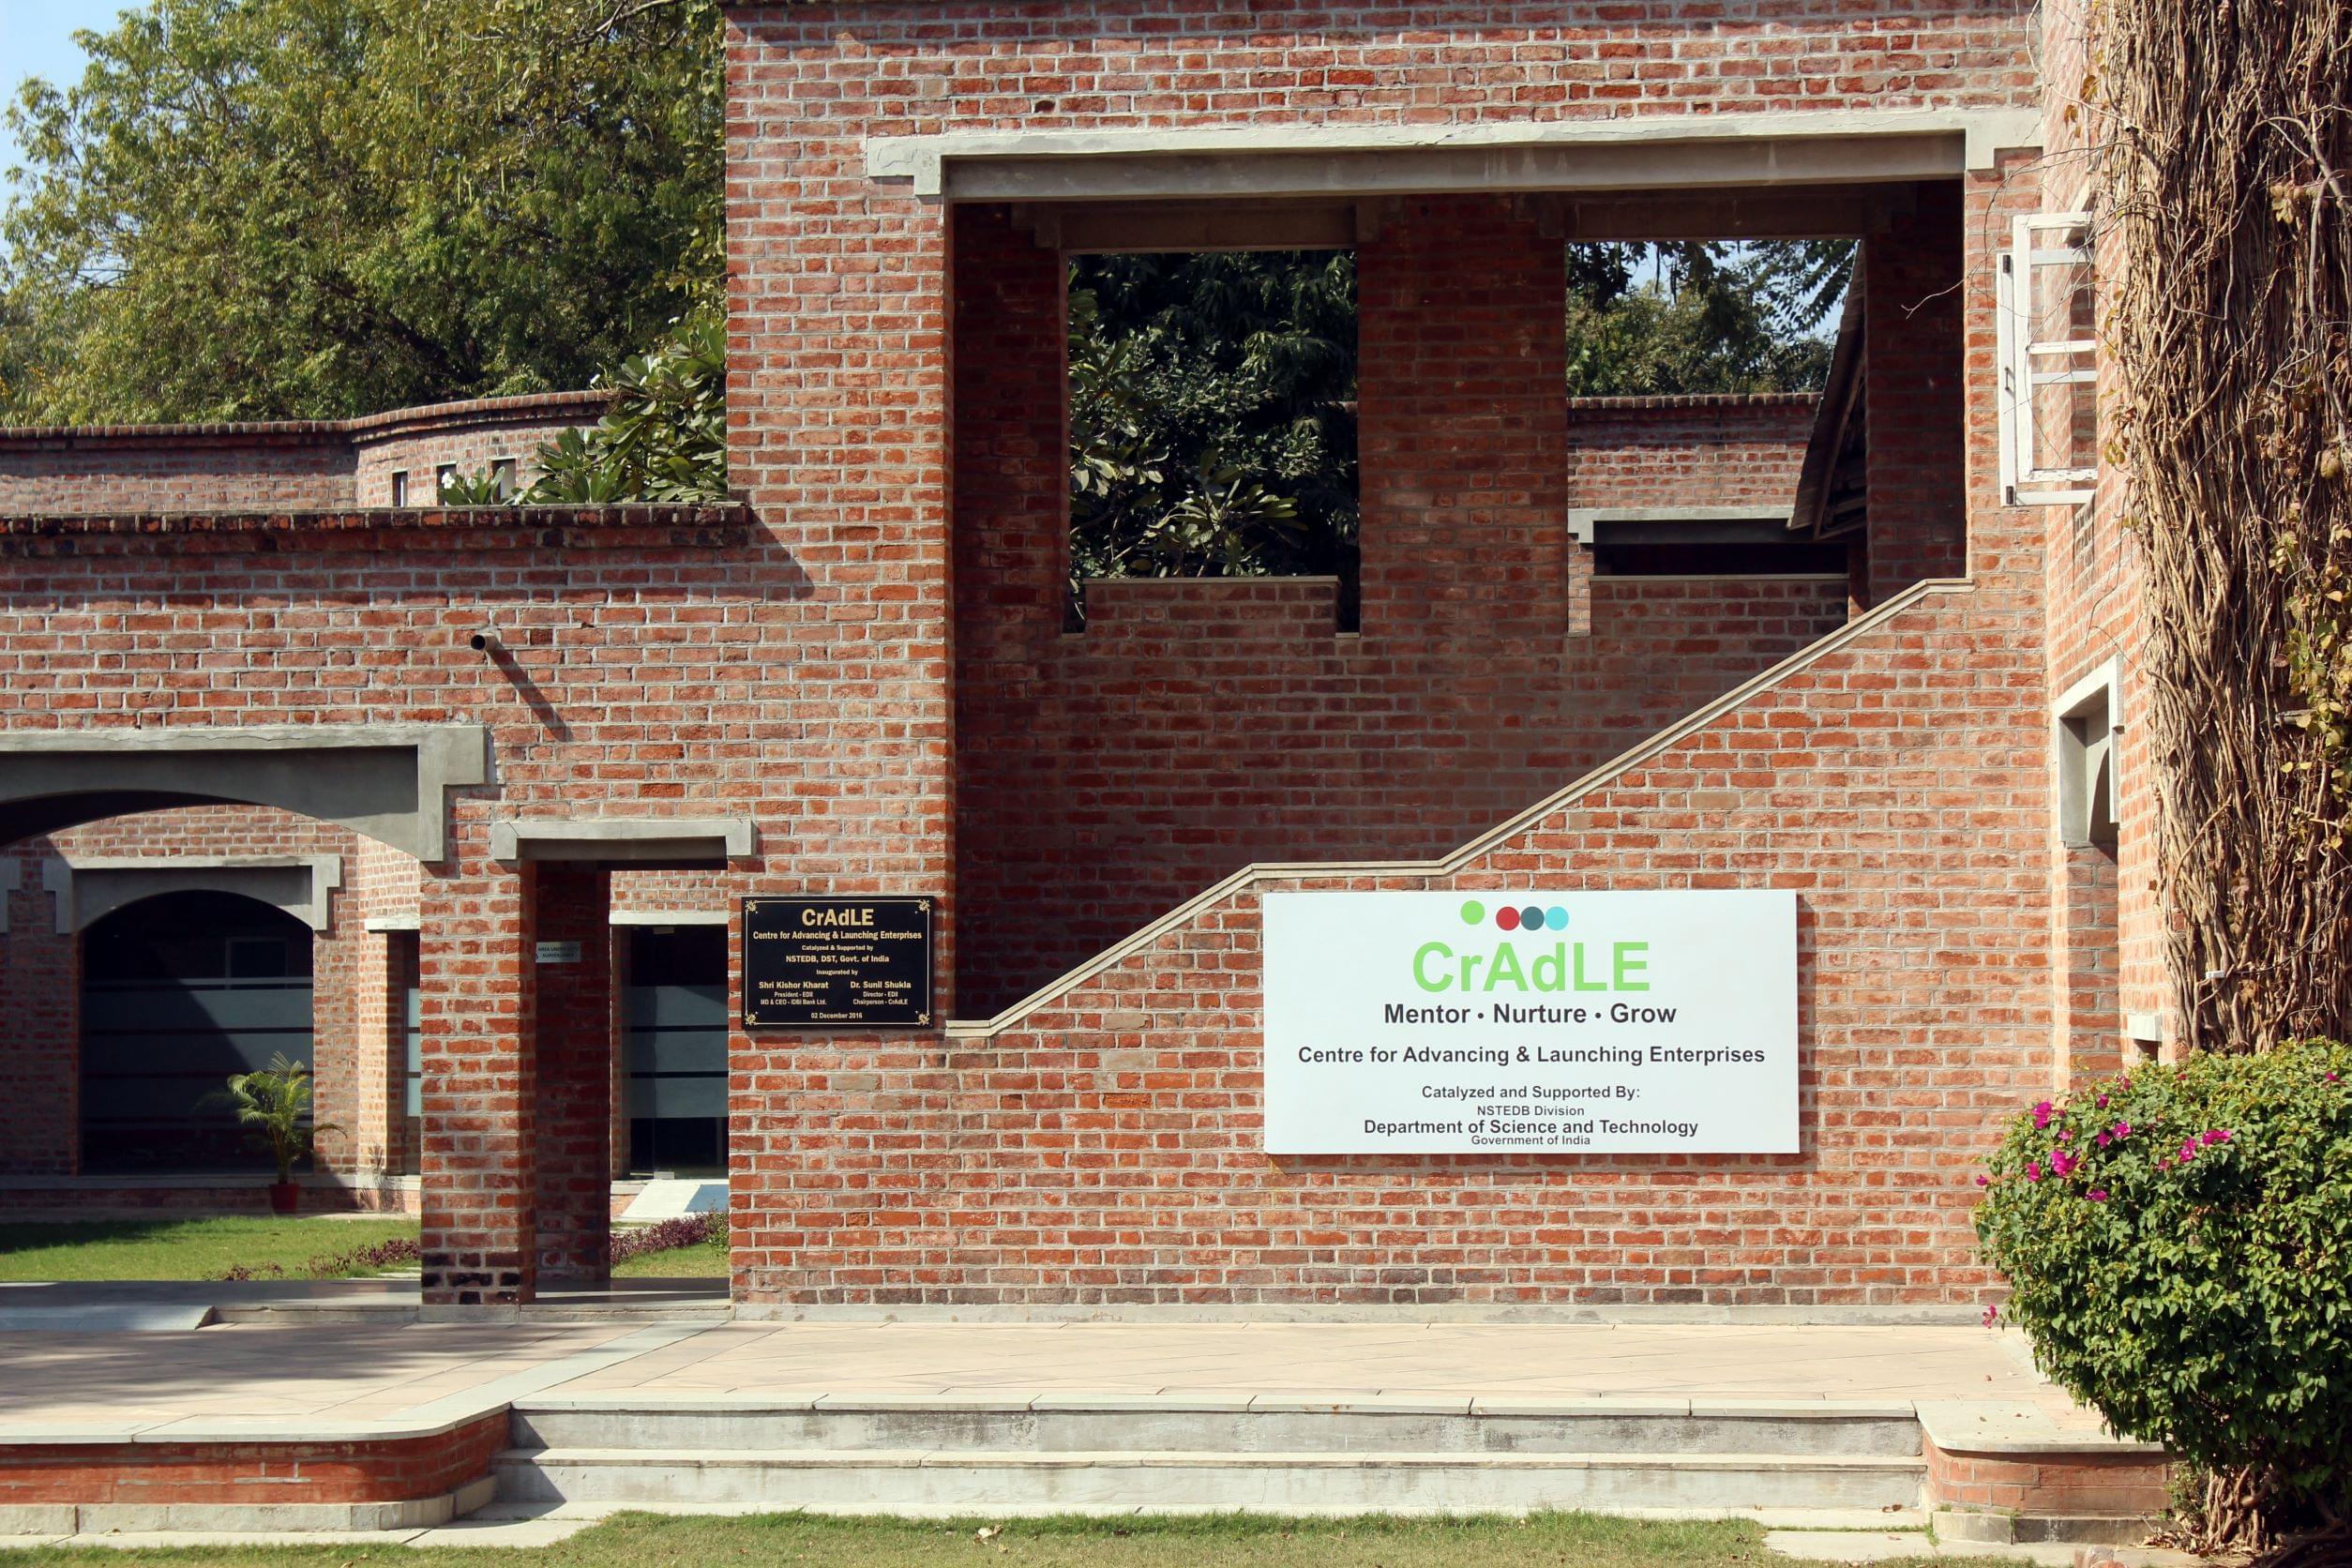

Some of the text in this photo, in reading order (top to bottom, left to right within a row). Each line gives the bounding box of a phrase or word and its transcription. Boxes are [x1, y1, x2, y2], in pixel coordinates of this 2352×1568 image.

[802, 909, 874, 926] CrAdLE
[792, 931, 830, 941] Advancing
[840, 930, 878, 941] Launching
[881, 931, 922, 941] Enterprises
[1413, 942, 1650, 992] CrAdLE
[1385, 1004, 1470, 1023] Mentor
[1494, 1003, 1586, 1023] Nurture
[1610, 1003, 1677, 1023] Grow
[1299, 1047, 1764, 1066] Centre for Advancing & Launching Enterprises
[1423, 1086, 1639, 1101] Catalyzed and Supported By:
[1478, 1106, 1584, 1115] NSTEDB Division
[1364, 1120, 1697, 1137] Department of Science and Technology
[1471, 1136, 1590, 1144] Government of India
